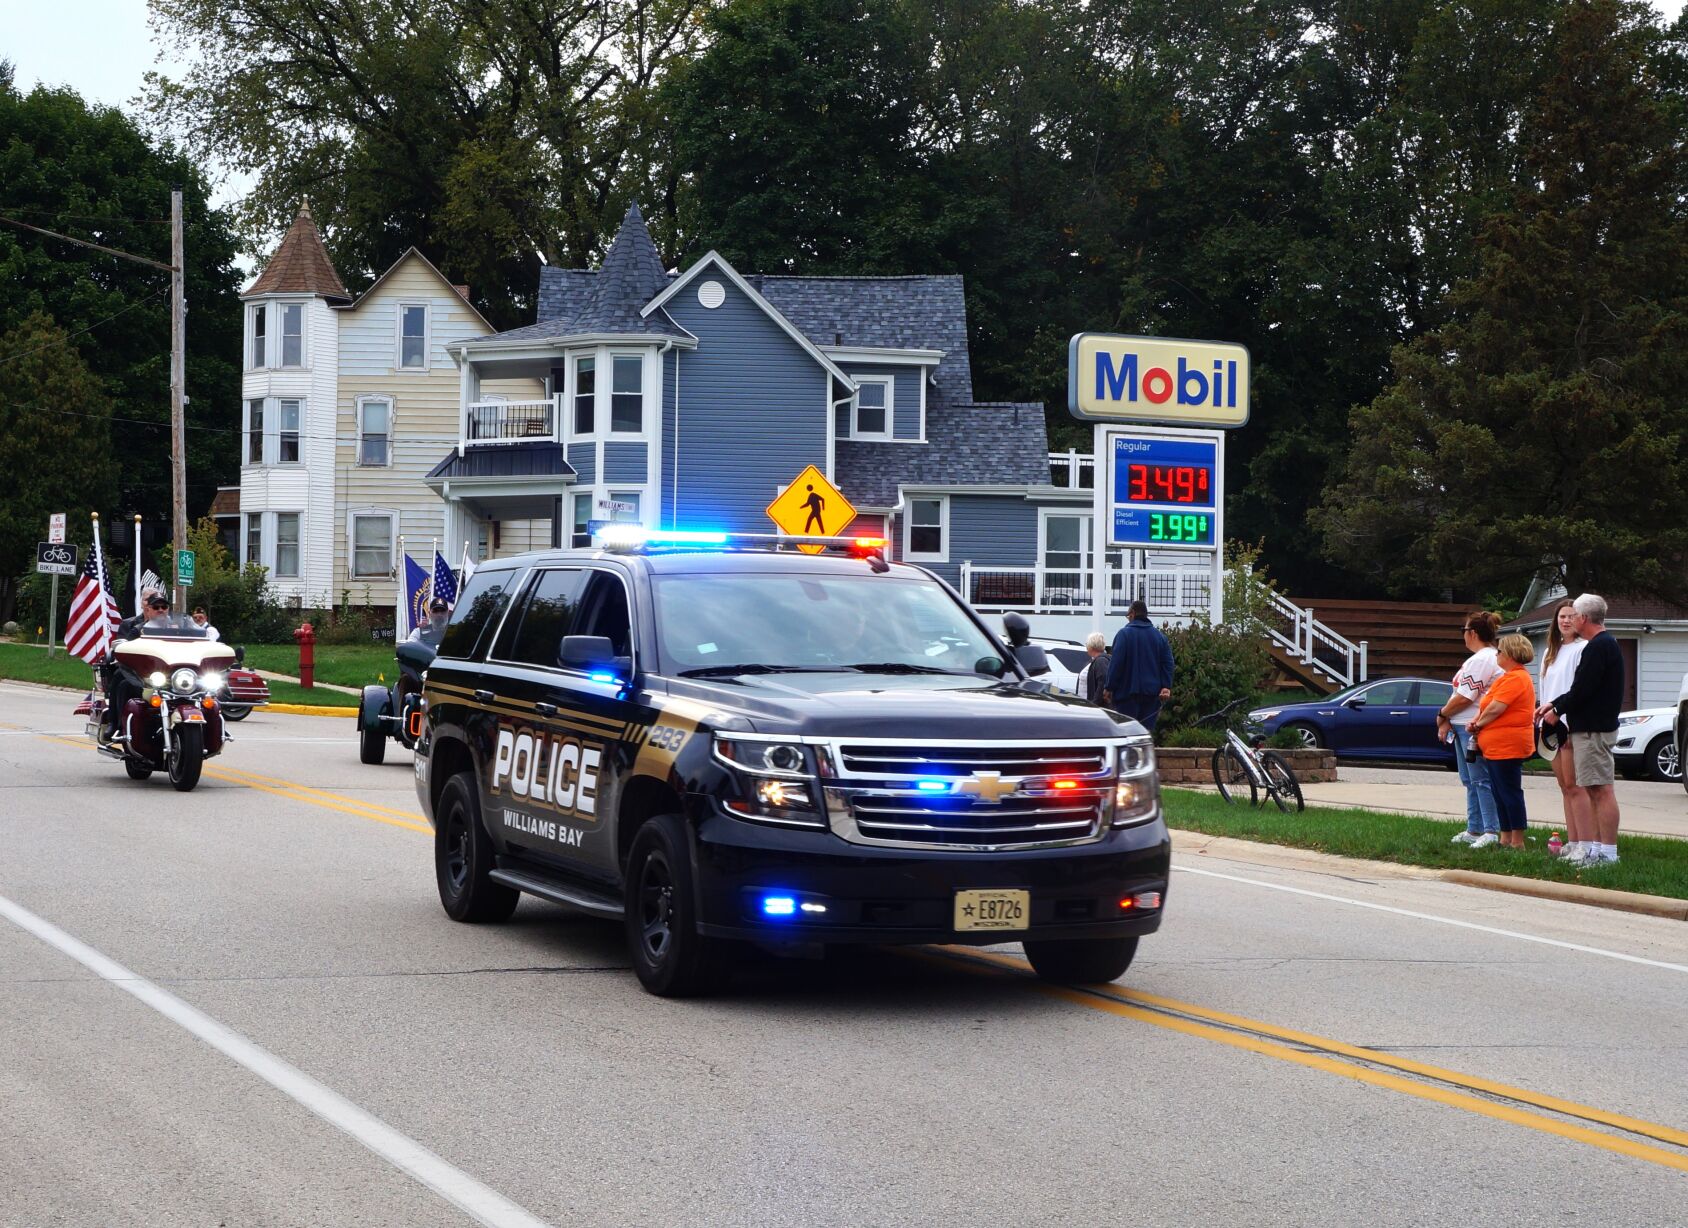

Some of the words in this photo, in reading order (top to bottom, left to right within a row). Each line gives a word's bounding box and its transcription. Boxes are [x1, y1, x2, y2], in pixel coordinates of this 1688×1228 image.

[1095, 351, 1237, 407] Mobil
[1116, 440, 1152, 452] Regular
[598, 500, 625, 511] WILLIAMS
[1116, 510, 1134, 518] Diesel
[39, 564, 54, 572] BIKE
[55, 565, 74, 573] LANE
[648, 725, 687, 752] 293
[415, 757, 426, 782] 911
[492, 728, 602, 815] POLICE
[503, 809, 556, 840] WILLIAMS
[558, 825, 584, 847] BAY
[979, 899, 1022, 920] E8726
